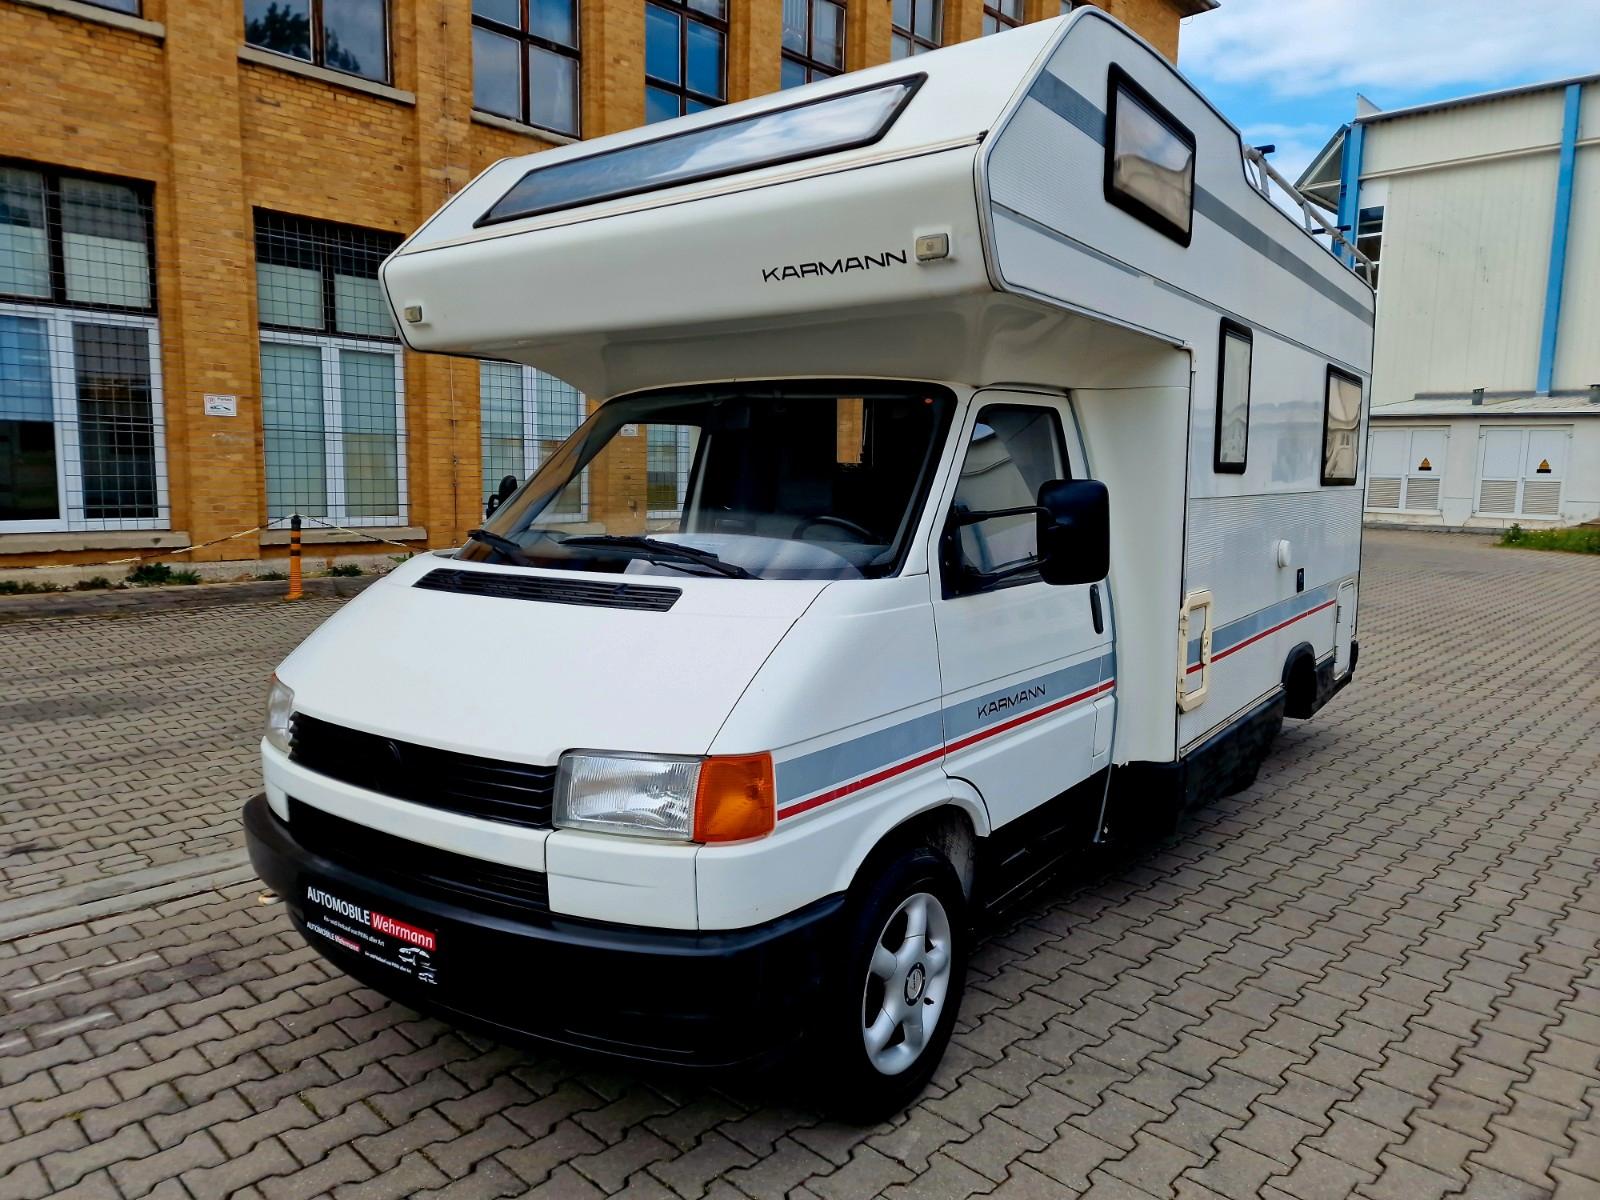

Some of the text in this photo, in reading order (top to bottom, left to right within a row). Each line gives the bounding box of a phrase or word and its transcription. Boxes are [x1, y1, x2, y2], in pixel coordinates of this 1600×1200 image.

[762, 249, 907, 282] KARMANN
[977, 683, 1046, 718] KARMANN
[306, 886, 371, 926] AUTOMOBILE
[372, 912, 433, 949] Wehrmann
